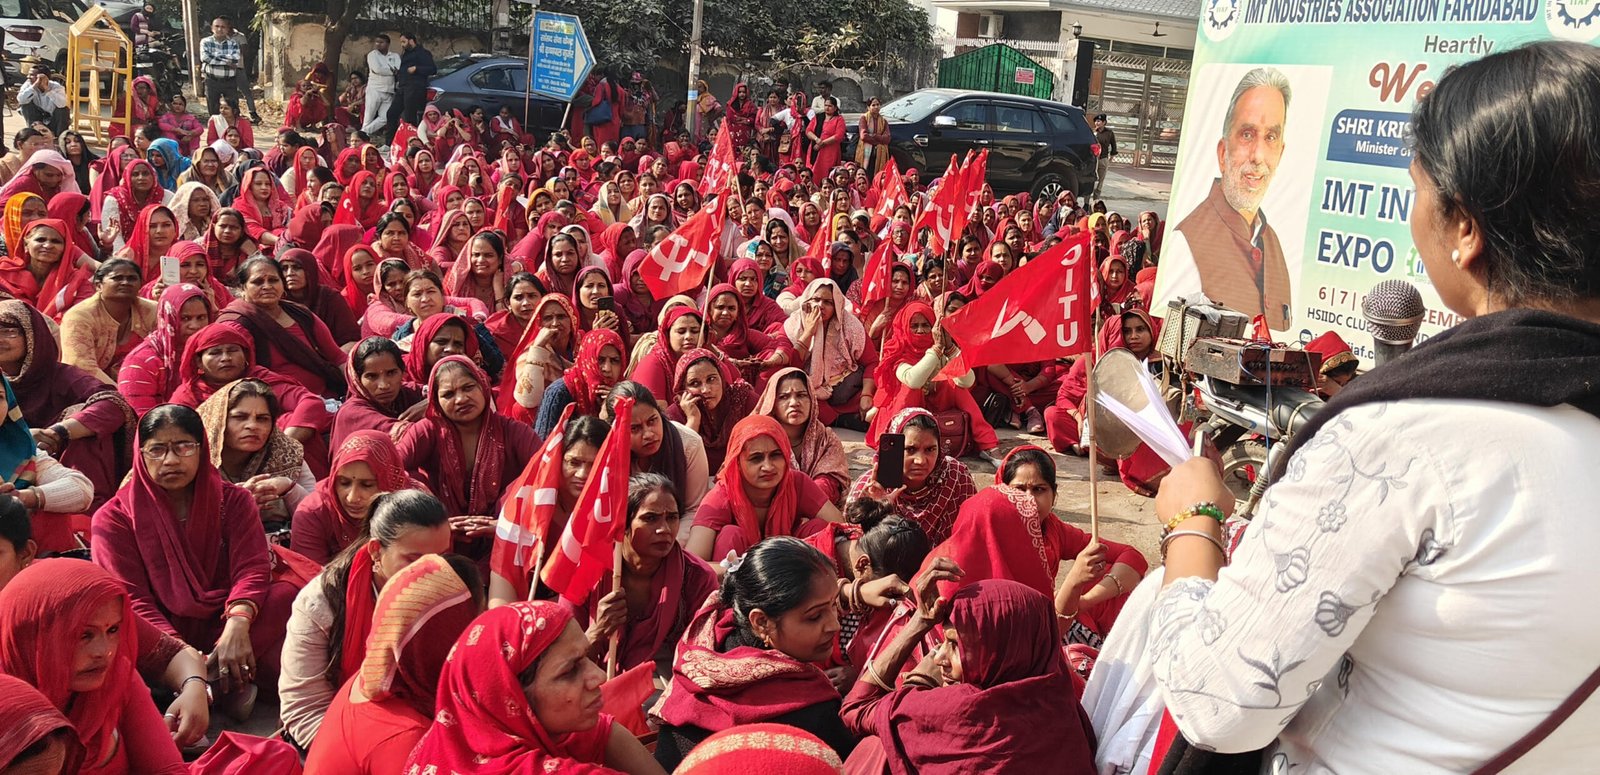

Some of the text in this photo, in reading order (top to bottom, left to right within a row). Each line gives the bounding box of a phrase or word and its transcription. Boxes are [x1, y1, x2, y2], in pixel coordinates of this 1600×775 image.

[1244, 0, 1267, 23] IMT
[1267, 0, 1343, 23] INDUSTRIES
[1343, 0, 1440, 22] ASSOCIATION
[1442, 0, 1538, 22] FARIDABAD
[1424, 34, 1493, 54] Heartly
[1336, 117, 1412, 139] SHRI KRIS
[1356, 140, 1399, 155] Minister
[1322, 179, 1413, 222] IMT IN
[1318, 231, 1395, 273] EXPO
[1318, 286, 1327, 300] 6
[1340, 291, 1348, 304] 7
[1307, 307, 1343, 325] HSIIDC
